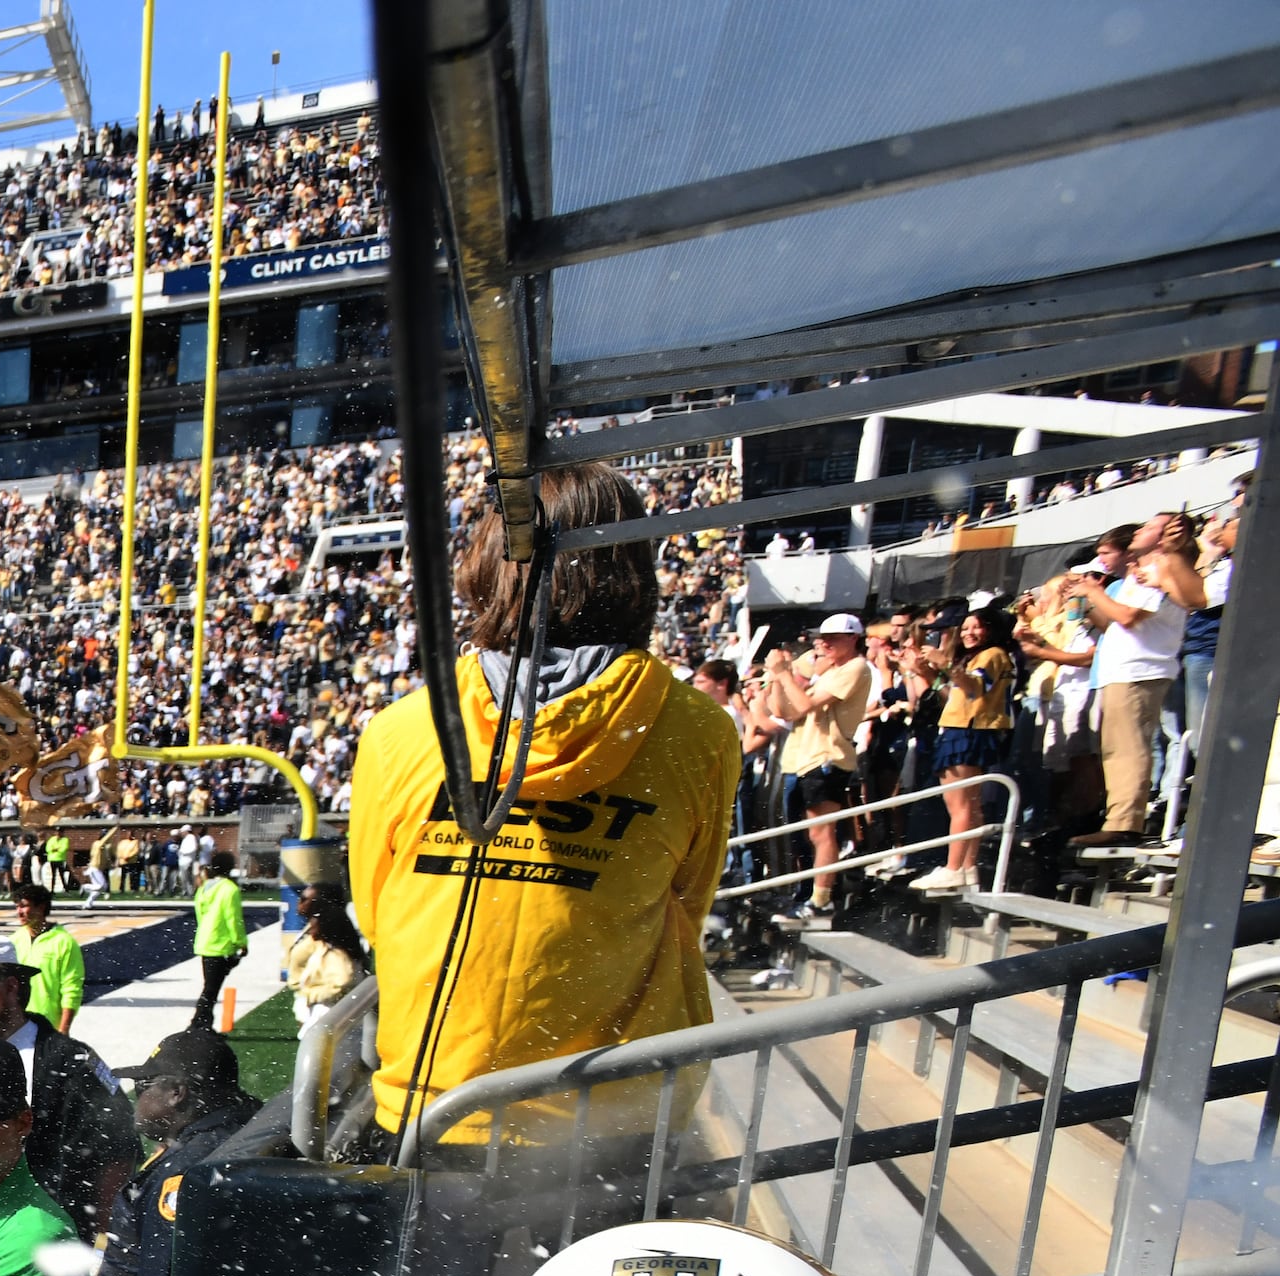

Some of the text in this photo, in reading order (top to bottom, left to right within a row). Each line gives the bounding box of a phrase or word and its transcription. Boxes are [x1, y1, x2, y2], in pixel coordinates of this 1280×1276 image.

[251, 257, 306, 279] CLINT
[434, 833, 534, 851] GARORLD
[540, 838, 614, 863] COMPANY
[509, 862, 567, 880] STAFF
[622, 1259, 709, 1271] GEORGIA
